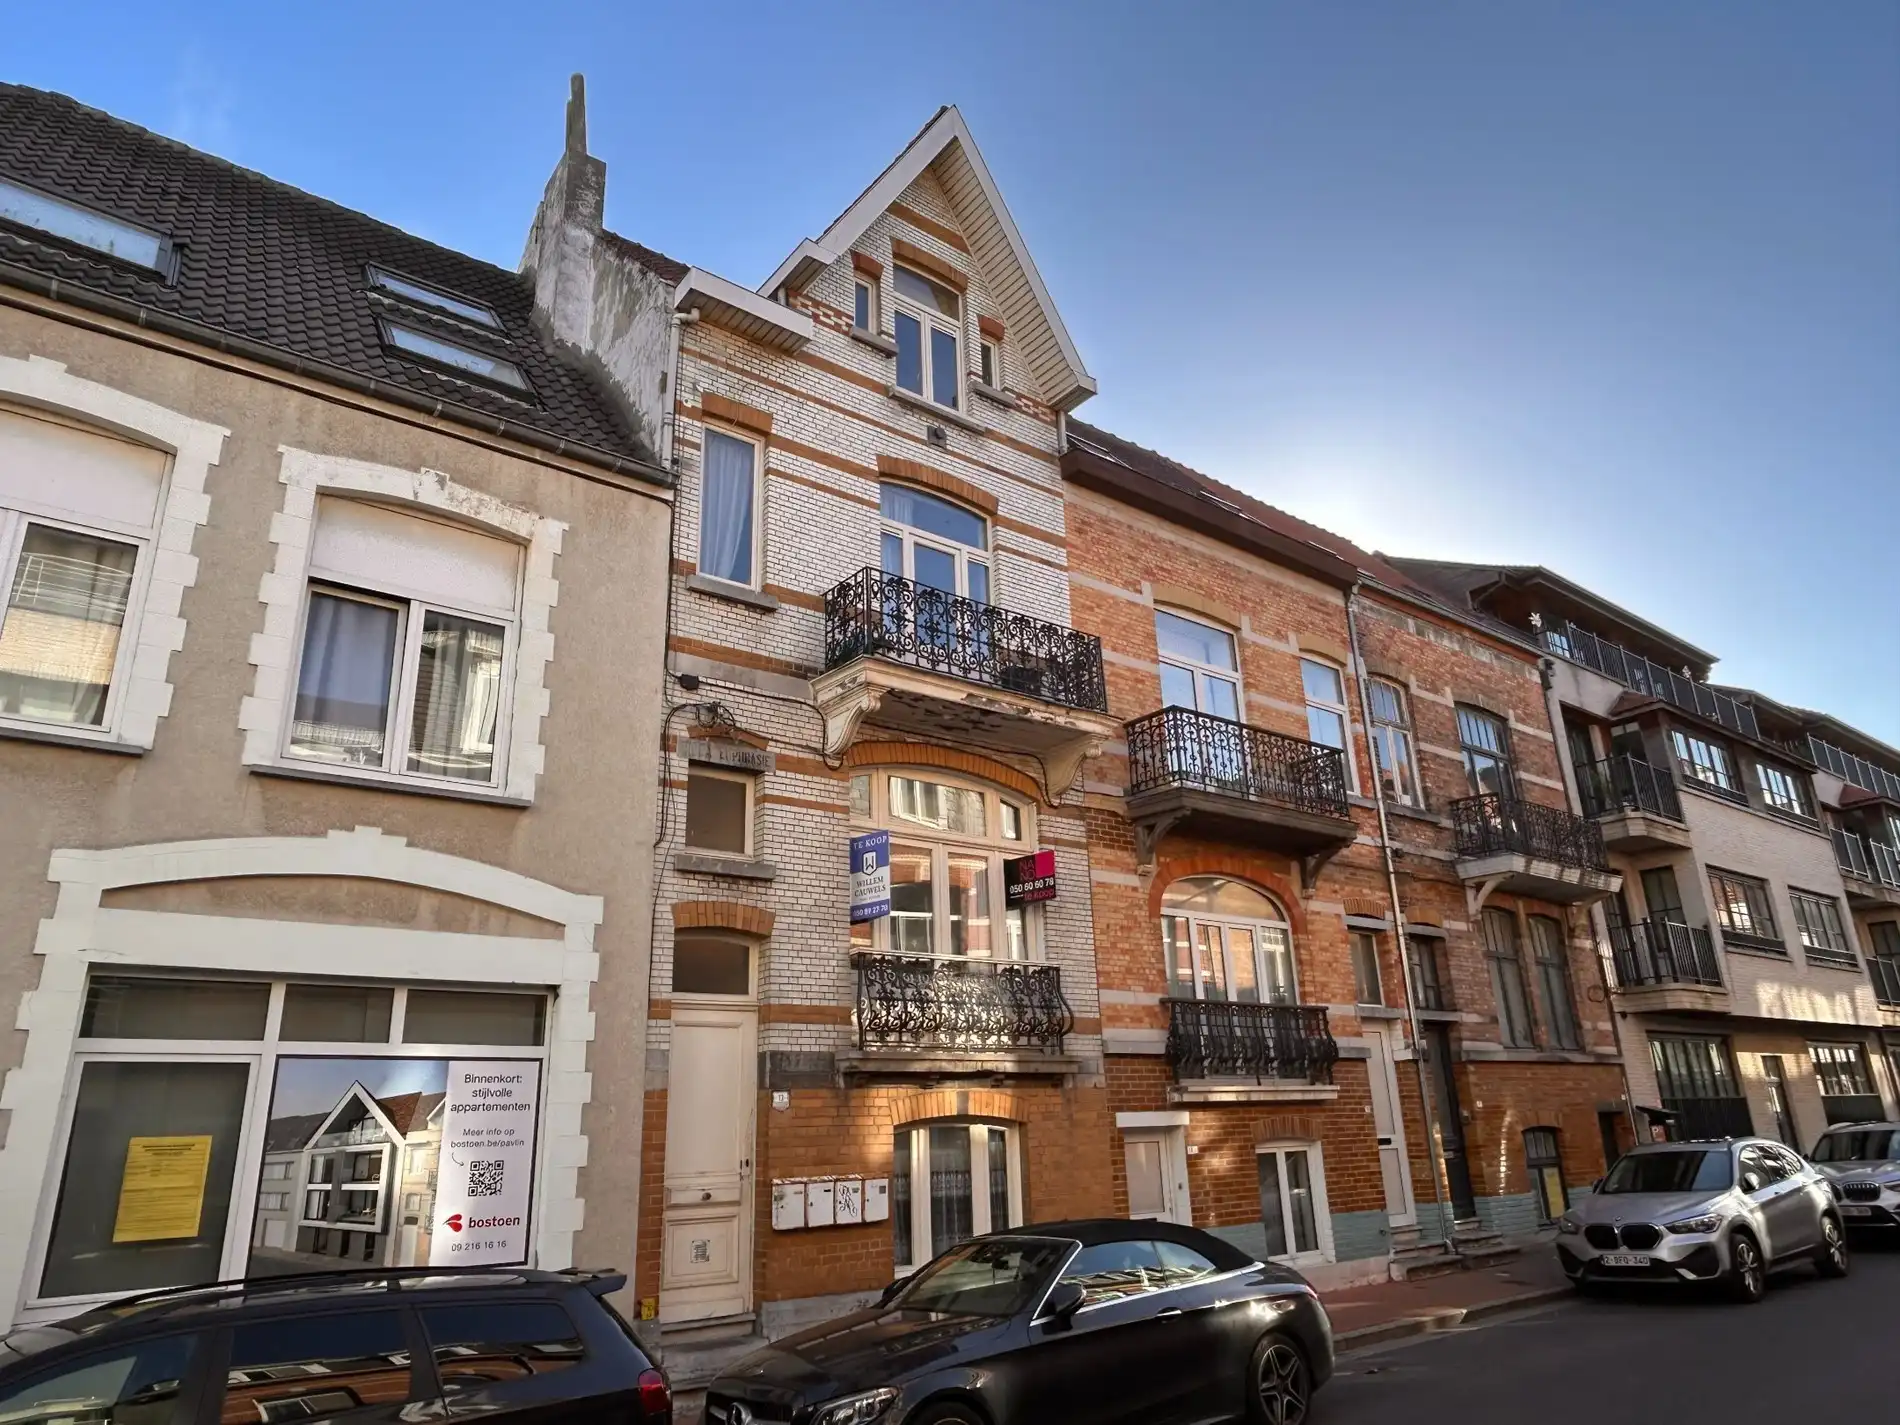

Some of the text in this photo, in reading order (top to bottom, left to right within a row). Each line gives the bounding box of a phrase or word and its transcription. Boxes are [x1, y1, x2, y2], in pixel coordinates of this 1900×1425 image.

[853, 836, 887, 850] TE KOOP
[856, 875, 884, 888] WILLEM
[1010, 877, 1054, 894] 050 60 60 78
[854, 884, 886, 898] CAUWELS
[464, 1073, 523, 1084] Binnenkort:
[472, 1088, 513, 1099] stijlvolle
[450, 1102, 531, 1114] appartementen
[486, 1128, 502, 1136] info
[504, 1128, 515, 1137] op
[468, 1216, 521, 1229] bostoen
[451, 1240, 507, 1252] 09 216 16 16
